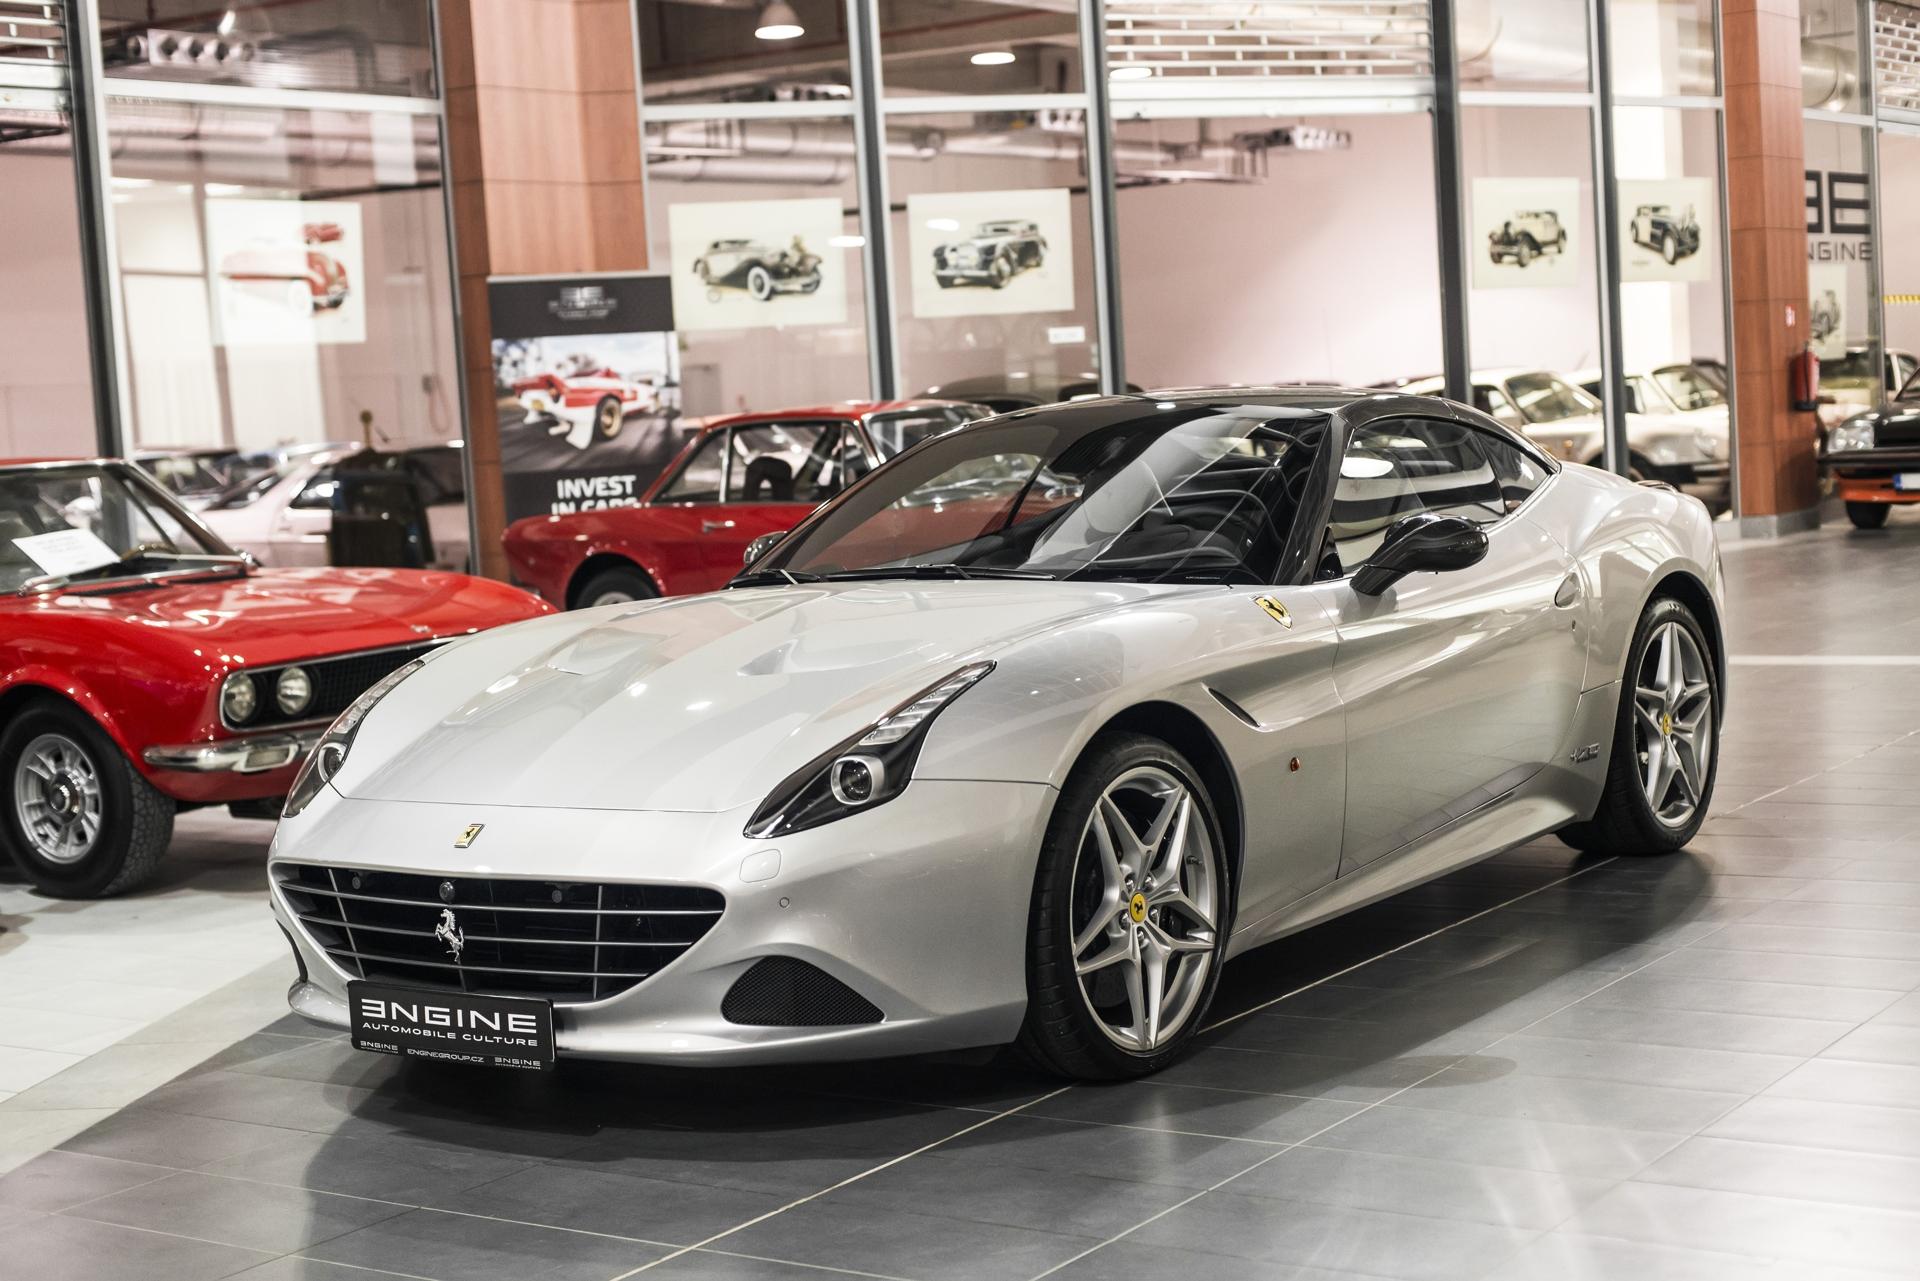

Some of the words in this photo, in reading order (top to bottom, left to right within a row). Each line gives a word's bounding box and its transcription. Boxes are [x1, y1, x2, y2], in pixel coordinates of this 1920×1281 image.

[557, 475, 636, 498] INVEST
[551, 501, 576, 515] IN
[362, 1022, 456, 1039] AUTOMOBILE
[462, 1034, 538, 1046] CULTURE
